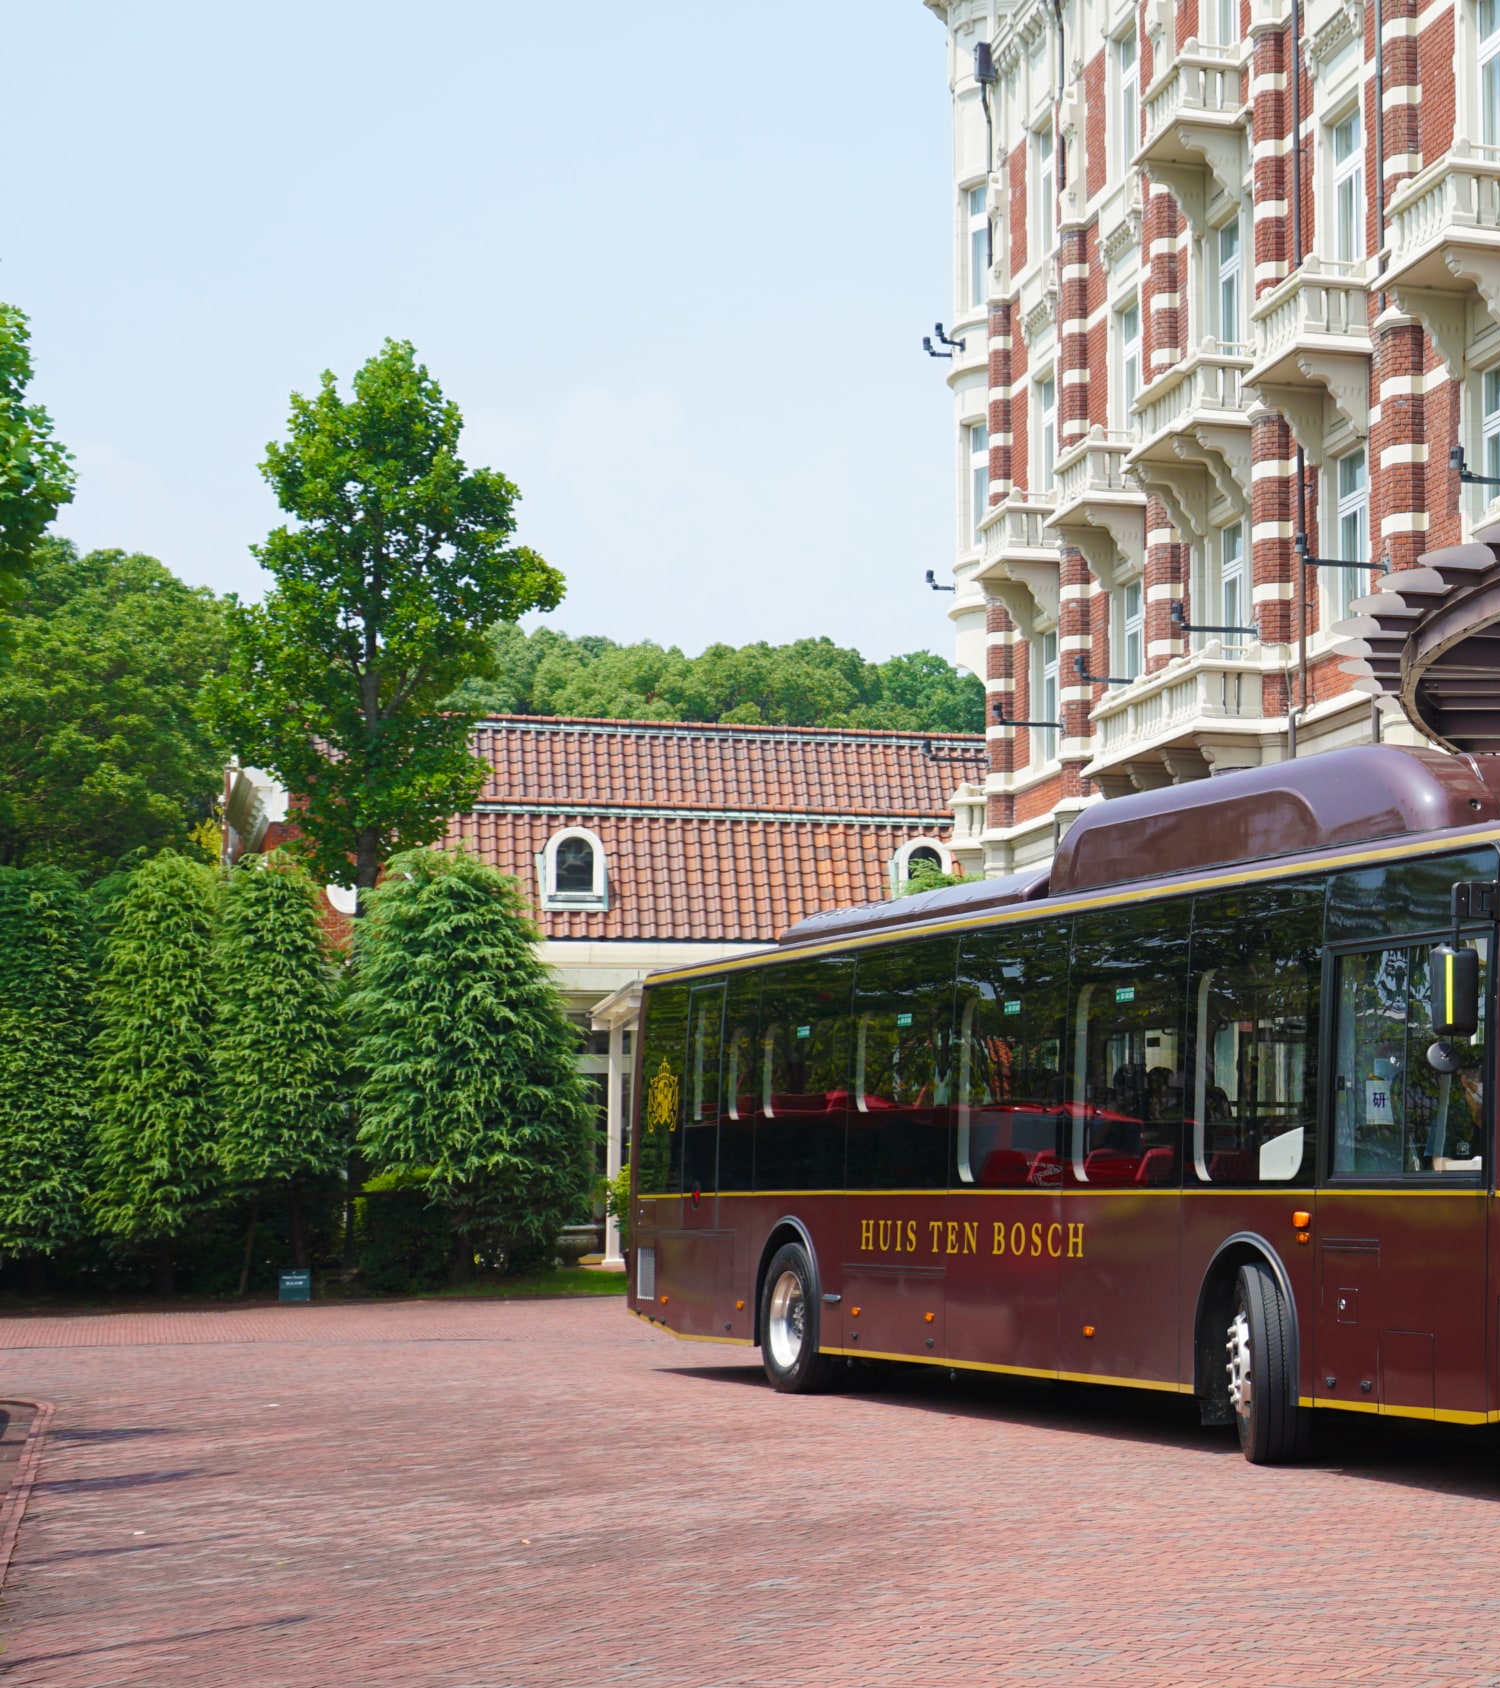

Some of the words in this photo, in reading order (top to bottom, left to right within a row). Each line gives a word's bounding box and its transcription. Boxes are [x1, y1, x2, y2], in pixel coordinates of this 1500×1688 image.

[860, 1219, 917, 1251] HUIS
[929, 1221, 979, 1254] TEN
[992, 1222, 1085, 1258] BOSCH
